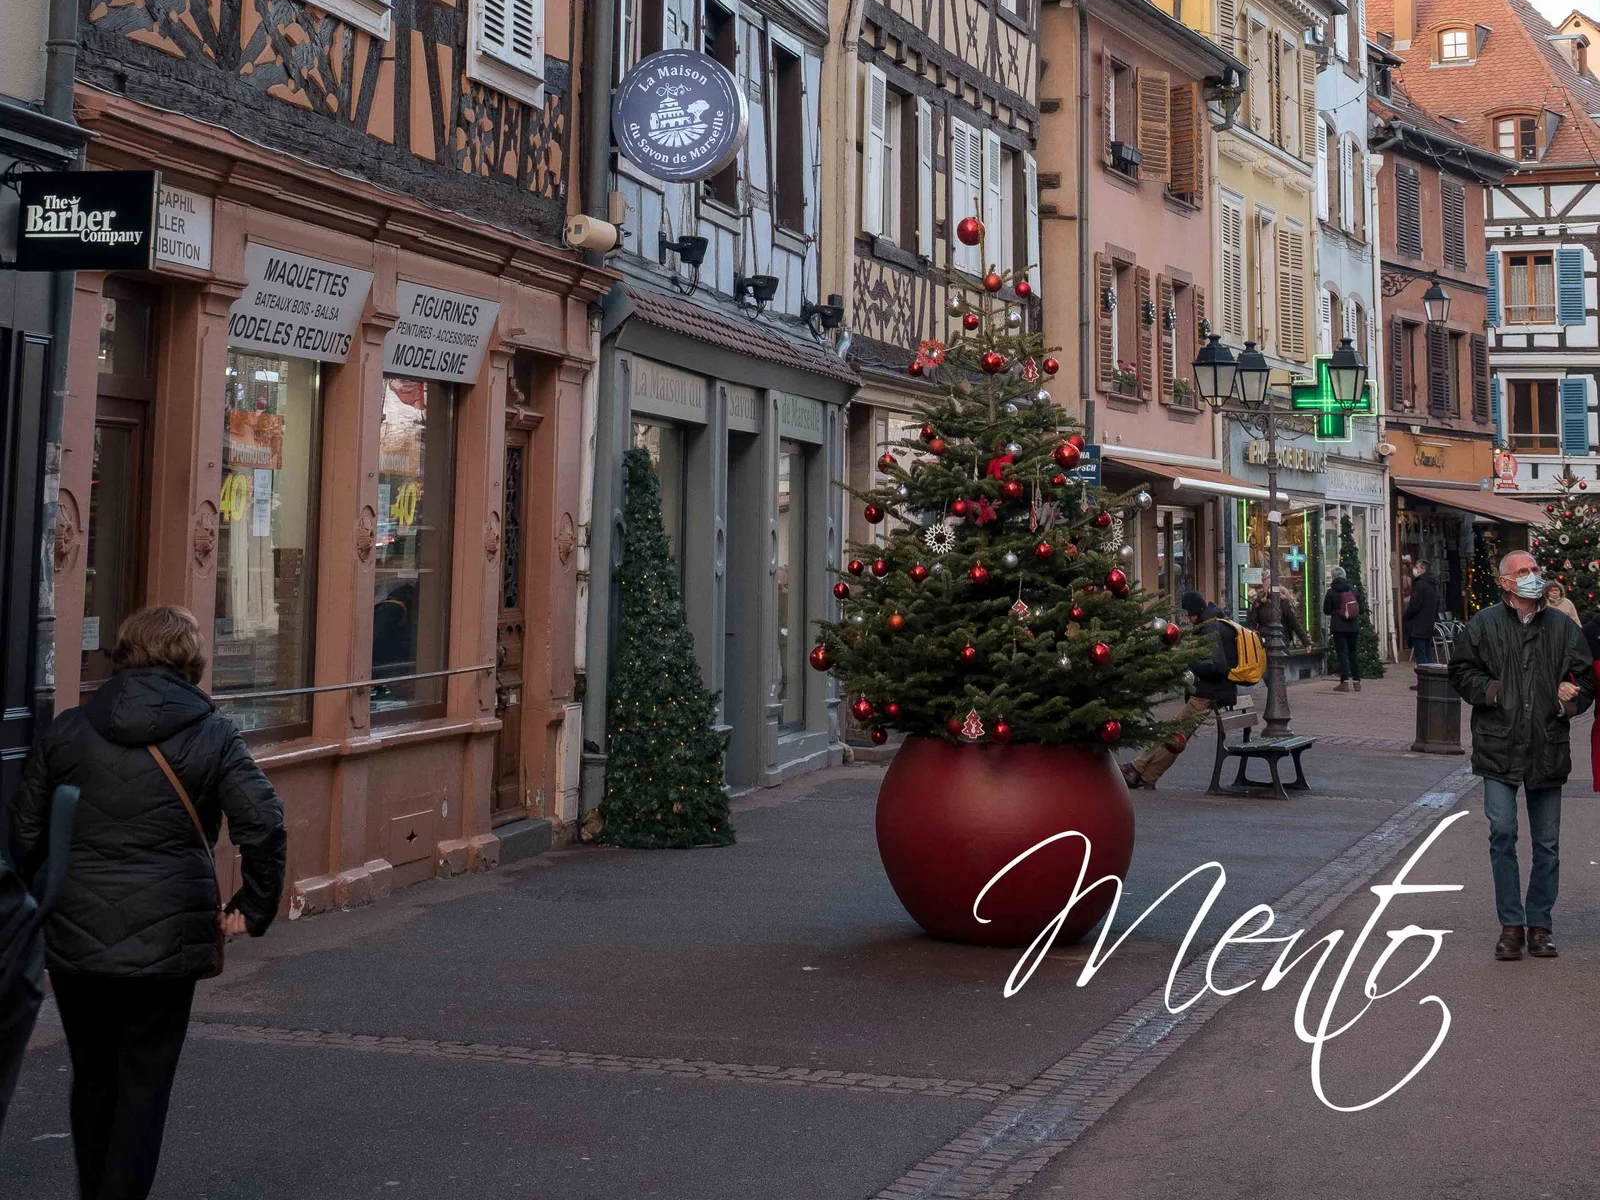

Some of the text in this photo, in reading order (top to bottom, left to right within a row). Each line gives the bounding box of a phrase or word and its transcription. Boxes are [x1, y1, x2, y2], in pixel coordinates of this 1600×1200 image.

[638, 64, 708, 93] La Maison
[629, 109, 724, 164] du Savon de Marseille
[43, 194, 68, 210] The
[159, 189, 196, 215] CAPHIL
[25, 203, 117, 232] Barber
[158, 212, 186, 235] LLER
[80, 228, 143, 246] Company
[157, 236, 201, 262] IBUTION
[263, 257, 349, 298] MAQUETTES
[254, 291, 293, 313] BATEAUX
[291, 299, 311, 316] BOIS
[314, 304, 340, 322] BALSA
[411, 293, 479, 327] FIGURINES
[293, 325, 352, 356] REDUITS
[396, 321, 433, 340] PEINTURES
[435, 328, 479, 348] ACCESSOIRES
[391, 343, 469, 375] MODELISME
[634, 362, 702, 409] La Maison du
[729, 388, 757, 421] Savon
[781, 394, 821, 432] de Marseille
[1252, 440, 1293, 469] PHAACIE
[1295, 448, 1304, 470] DE
